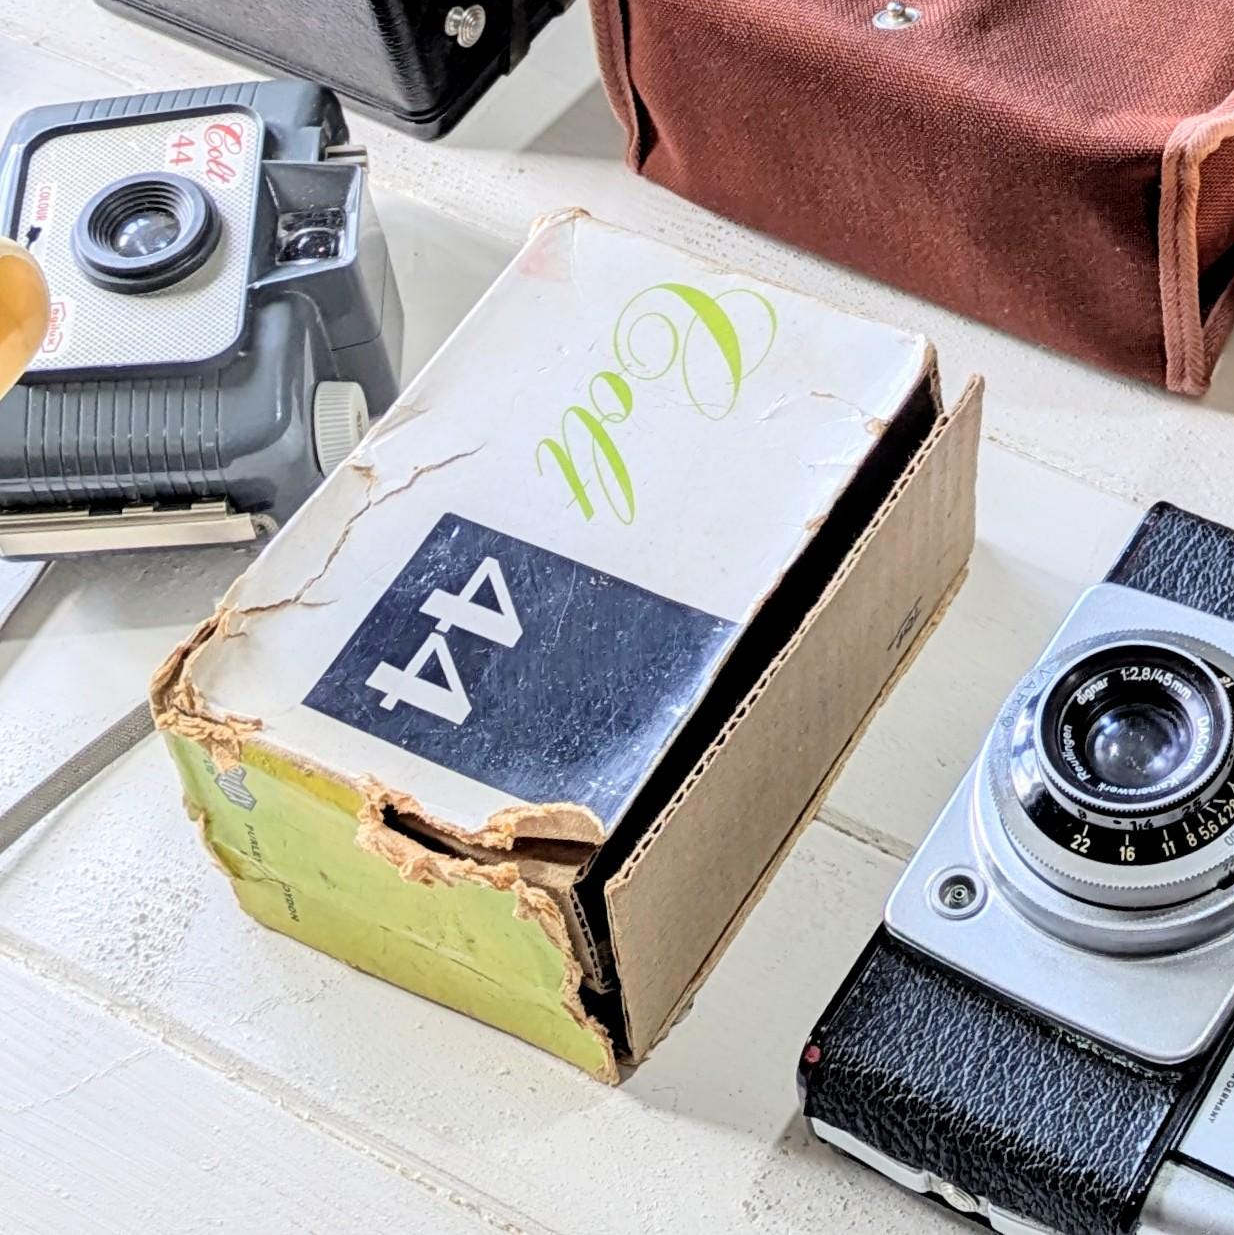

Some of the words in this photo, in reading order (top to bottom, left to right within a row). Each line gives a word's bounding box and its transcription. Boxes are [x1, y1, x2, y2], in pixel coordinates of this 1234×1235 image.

[169, 134, 196, 166] 44
[204, 122, 244, 185] Colt
[36, 186, 52, 222] COLOUR
[535, 283, 778, 526] Colt
[365, 556, 524, 726] 44
[1001, 668, 1056, 729] VARIO
[1076, 676, 1110, 706] dignar
[1060, 724, 1092, 782] Reutlingen
[1183, 716, 1211, 771] DACORA
[1098, 777, 1179, 797] Kamerawerk
[1070, 834, 1091, 854] 22
[1119, 845, 1136, 862] 16
[1161, 840, 1176, 857] 11
[1186, 832, 1198, 847] 8
[1217, 812, 1229, 826] 4
